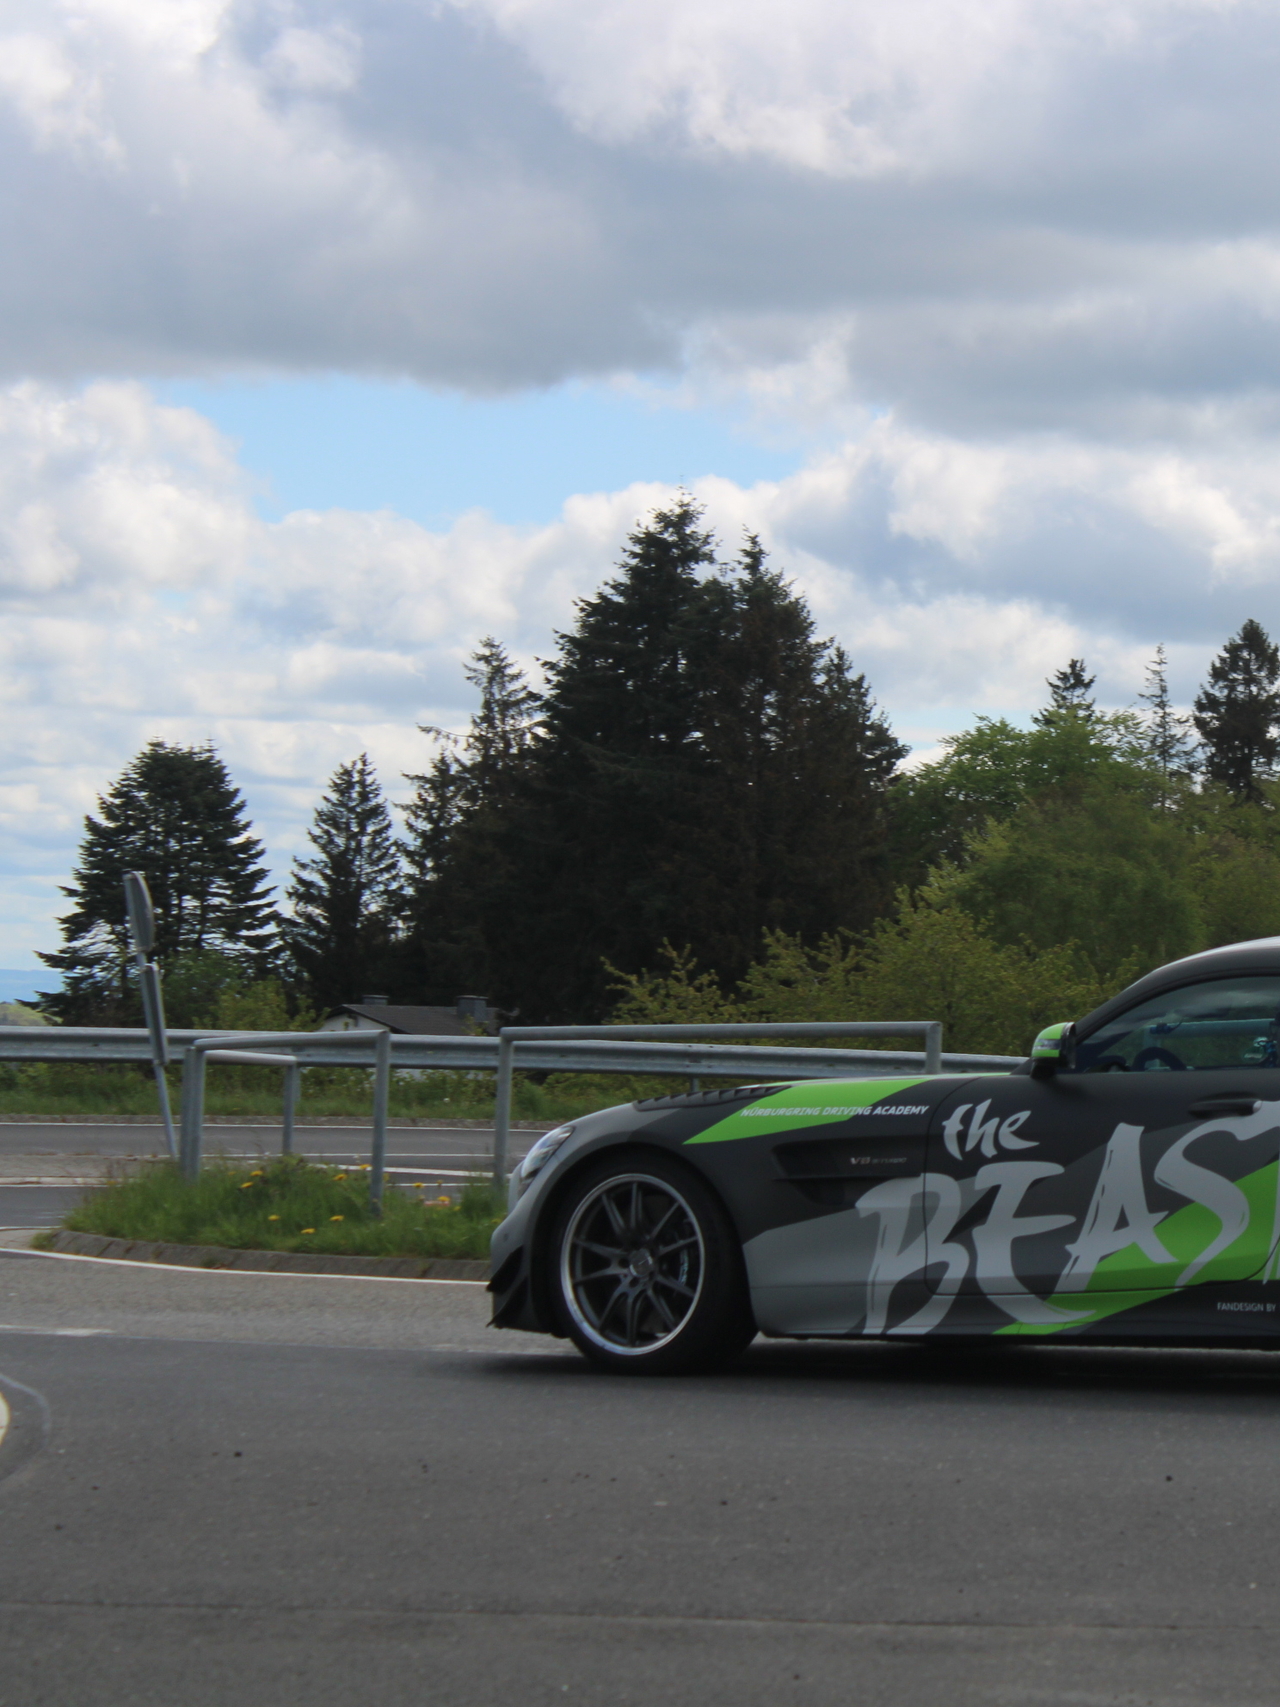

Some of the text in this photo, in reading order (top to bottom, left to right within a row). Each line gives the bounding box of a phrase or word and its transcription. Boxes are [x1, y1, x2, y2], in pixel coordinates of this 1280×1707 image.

[740, 1105, 930, 1117] NÜRBURGRING DRIVING ACADEMY
[942, 1098, 1040, 1160] the
[1217, 1302, 1264, 1312] FANDESIGN
[1266, 1303, 1276, 1312] BY
